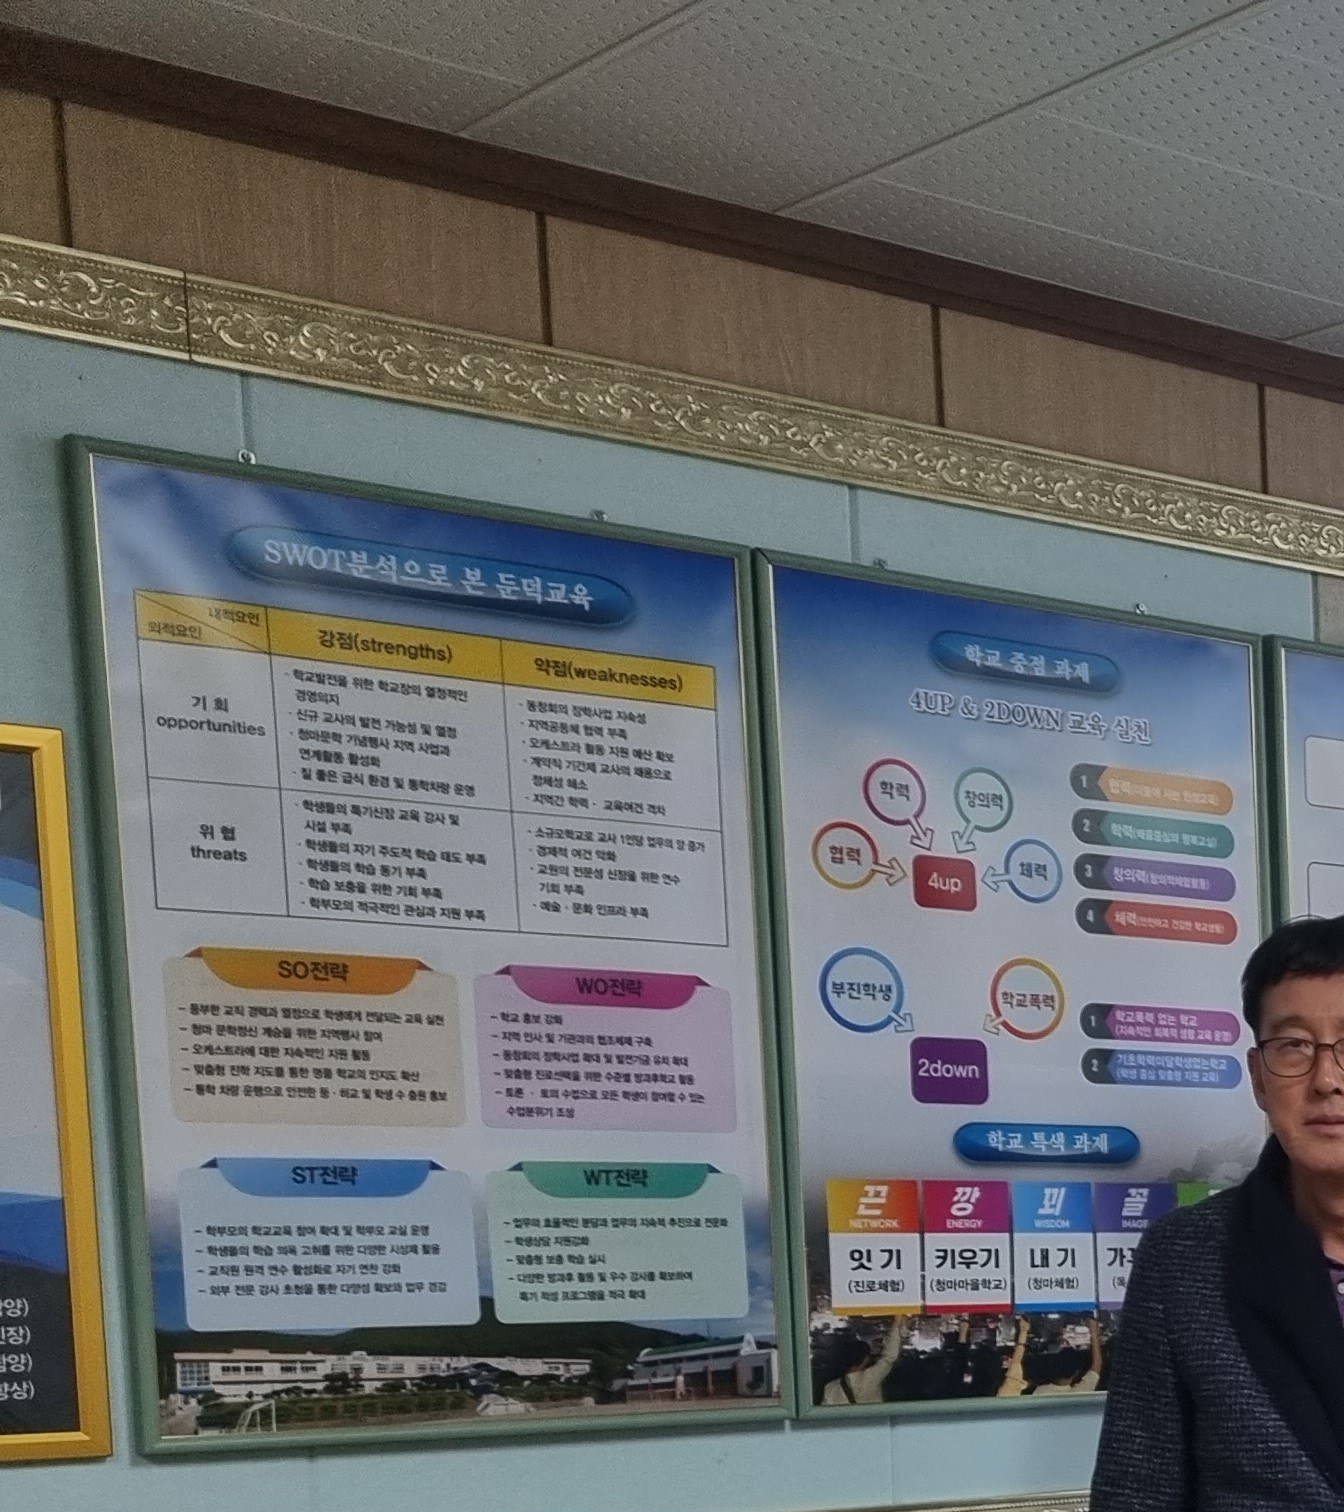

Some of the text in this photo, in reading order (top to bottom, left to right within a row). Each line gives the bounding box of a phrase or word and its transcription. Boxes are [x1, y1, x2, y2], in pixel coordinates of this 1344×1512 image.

[264, 540, 594, 611] SWOT분석으로 본 둔덕교육
[318, 629, 453, 663] 강점(strengths)
[964, 643, 1091, 685] 학교 중점 과제
[534, 658, 682, 692] 약점(weaknesses)
[157, 716, 266, 736] opportunities
[909, 688, 1152, 746] 4UP & 2DOWN 교육 실천
[880, 781, 910, 802] 학력
[1080, 775, 1087, 788] 1
[964, 789, 1004, 811] 창의력
[1083, 819, 1090, 832] 2
[191, 845, 248, 862] threats
[829, 845, 861, 866] 협력
[1019, 861, 1048, 880] 체력
[1085, 864, 1093, 878] 3
[927, 872, 962, 893] 4up
[1086, 910, 1094, 922] 4
[278, 960, 349, 982] SO전략
[575, 977, 642, 998] WO전략
[831, 981, 893, 1002] 부진학생
[1001, 991, 1056, 1011] 학교폭력
[1090, 1016, 1095, 1027] 1
[917, 1058, 980, 1079] 2down
[1091, 1059, 1098, 1071] 2
[987, 1130, 1109, 1154] 학교 특색 과제
[292, 1166, 358, 1185] ST전략
[583, 1169, 648, 1187] WT전략
[950, 1186, 981, 1216] 깡
[849, 1219, 899, 1229] NETWORK
[946, 1219, 982, 1228] ENERGY
[1034, 1219, 1069, 1228] WISDOM
[1122, 1220, 1148, 1228] IMAGE
[935, 1249, 999, 1269] 키우기
[848, 1279, 904, 1293] (진로체험)
[930, 1278, 1007, 1292] (청마마을학교)
[1028, 1277, 1079, 1290] (청마체험)
[0, 1298, 29, 1318] 양)
